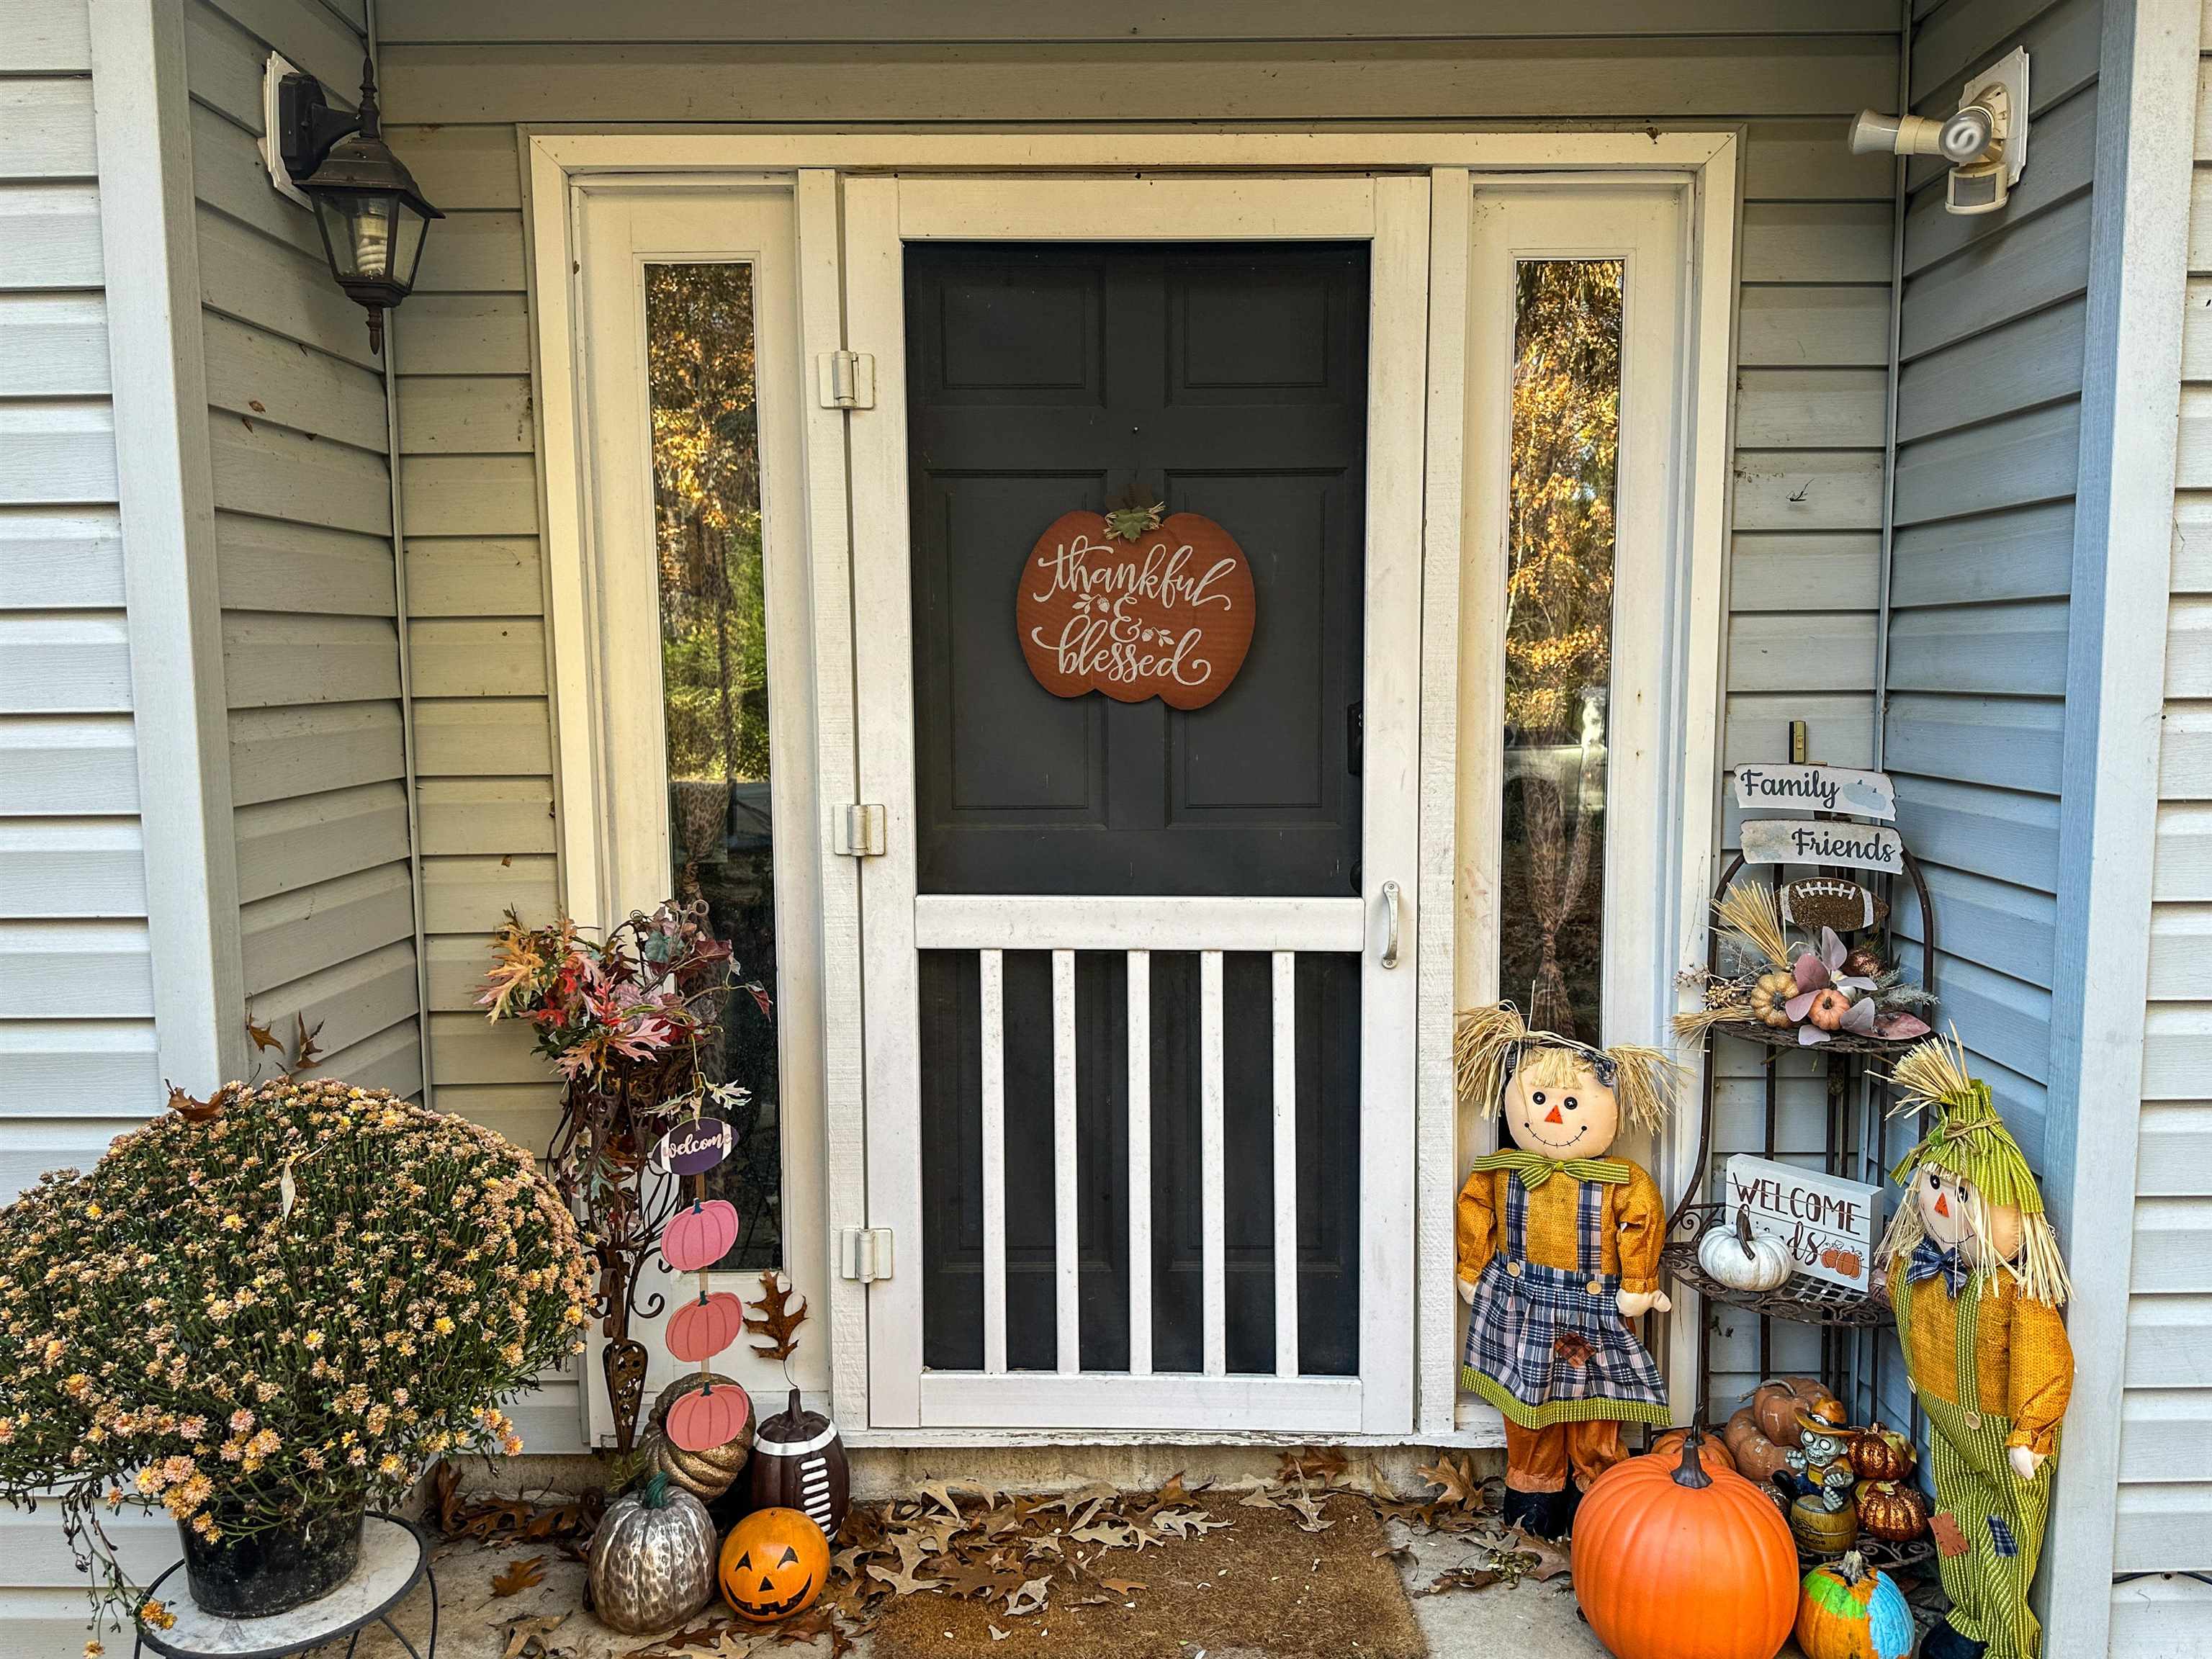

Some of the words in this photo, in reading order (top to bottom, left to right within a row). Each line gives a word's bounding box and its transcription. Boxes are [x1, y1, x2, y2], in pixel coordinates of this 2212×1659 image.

[1033, 535, 1236, 611] thankful
[1109, 593, 1143, 643] &
[1031, 614, 1211, 685] blessed
[1741, 769, 1840, 809] Family
[1791, 828, 1896, 863] Friends
[662, 1133, 732, 1159] welcome
[1732, 1172, 1861, 1236] WELCOME
